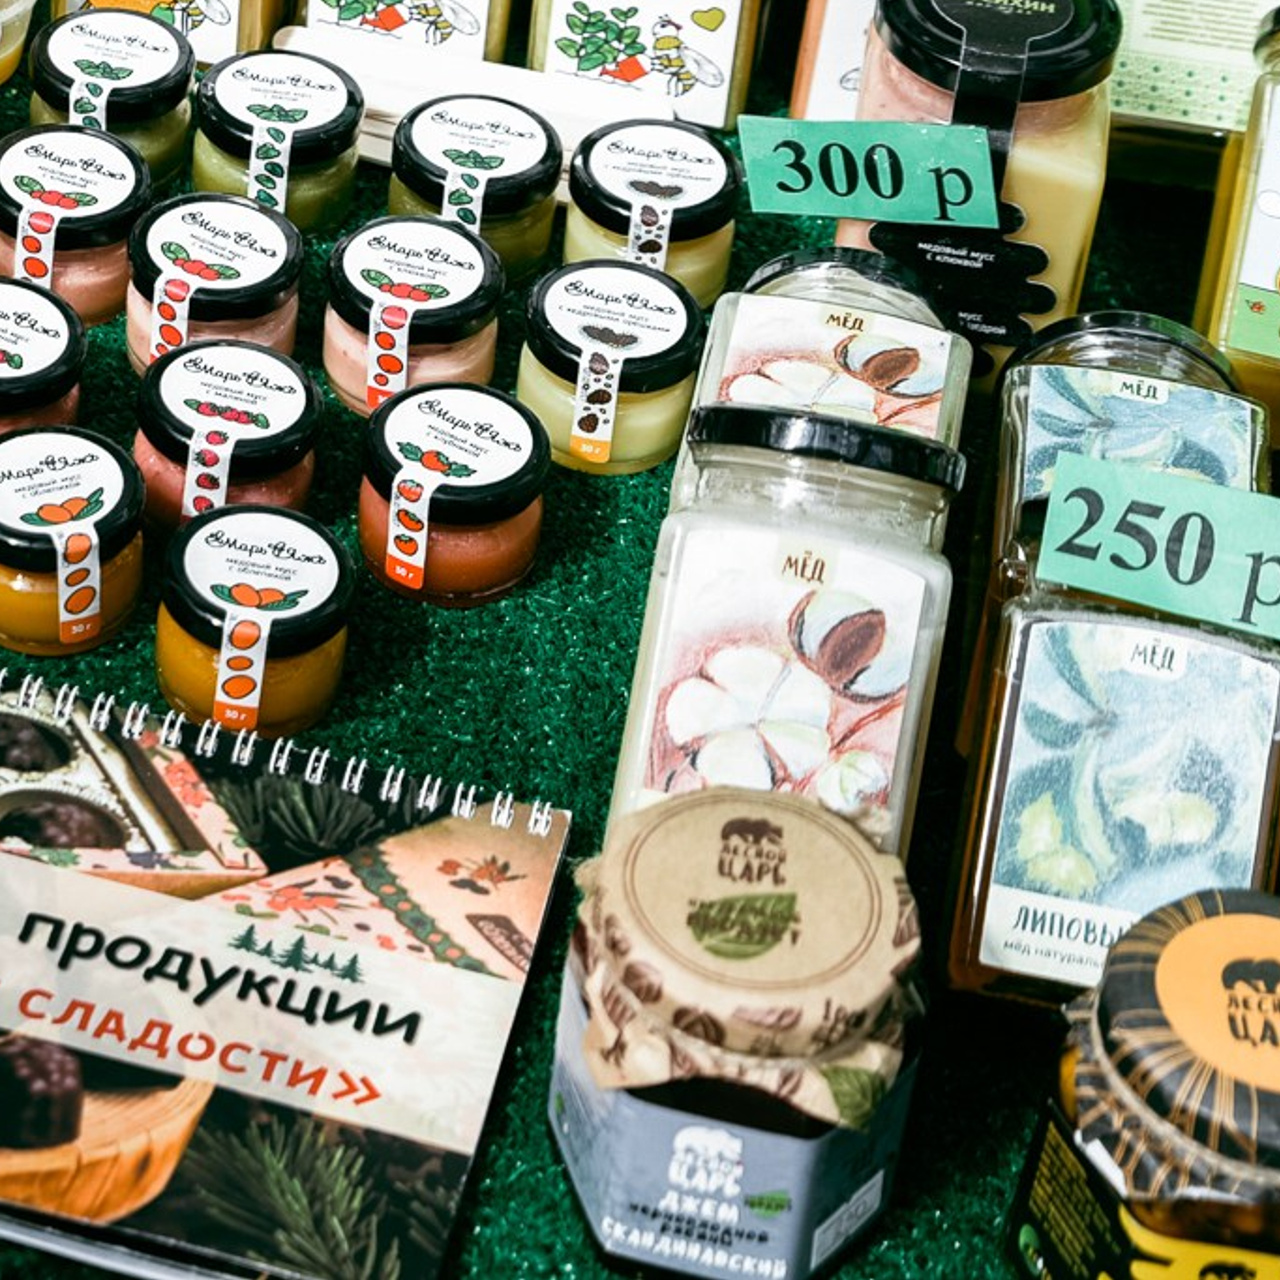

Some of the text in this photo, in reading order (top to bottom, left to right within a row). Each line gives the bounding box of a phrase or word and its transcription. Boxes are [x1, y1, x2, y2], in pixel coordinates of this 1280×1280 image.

[773, 140, 904, 200] 300
[826, 312, 864, 332] МЁД
[1120, 379, 1158, 402] МЁД
[1054, 486, 1216, 586] 250
[782, 549, 825, 584] МЁД
[1130, 636, 1175, 672] МЁД
[718, 858, 786, 886] ЦАРЬ
[1013, 905, 1125, 950] ЛИПОВЫ
[17, 908, 424, 1047] продукции
[17, 994, 382, 1108] СЛАДОСТИ»
